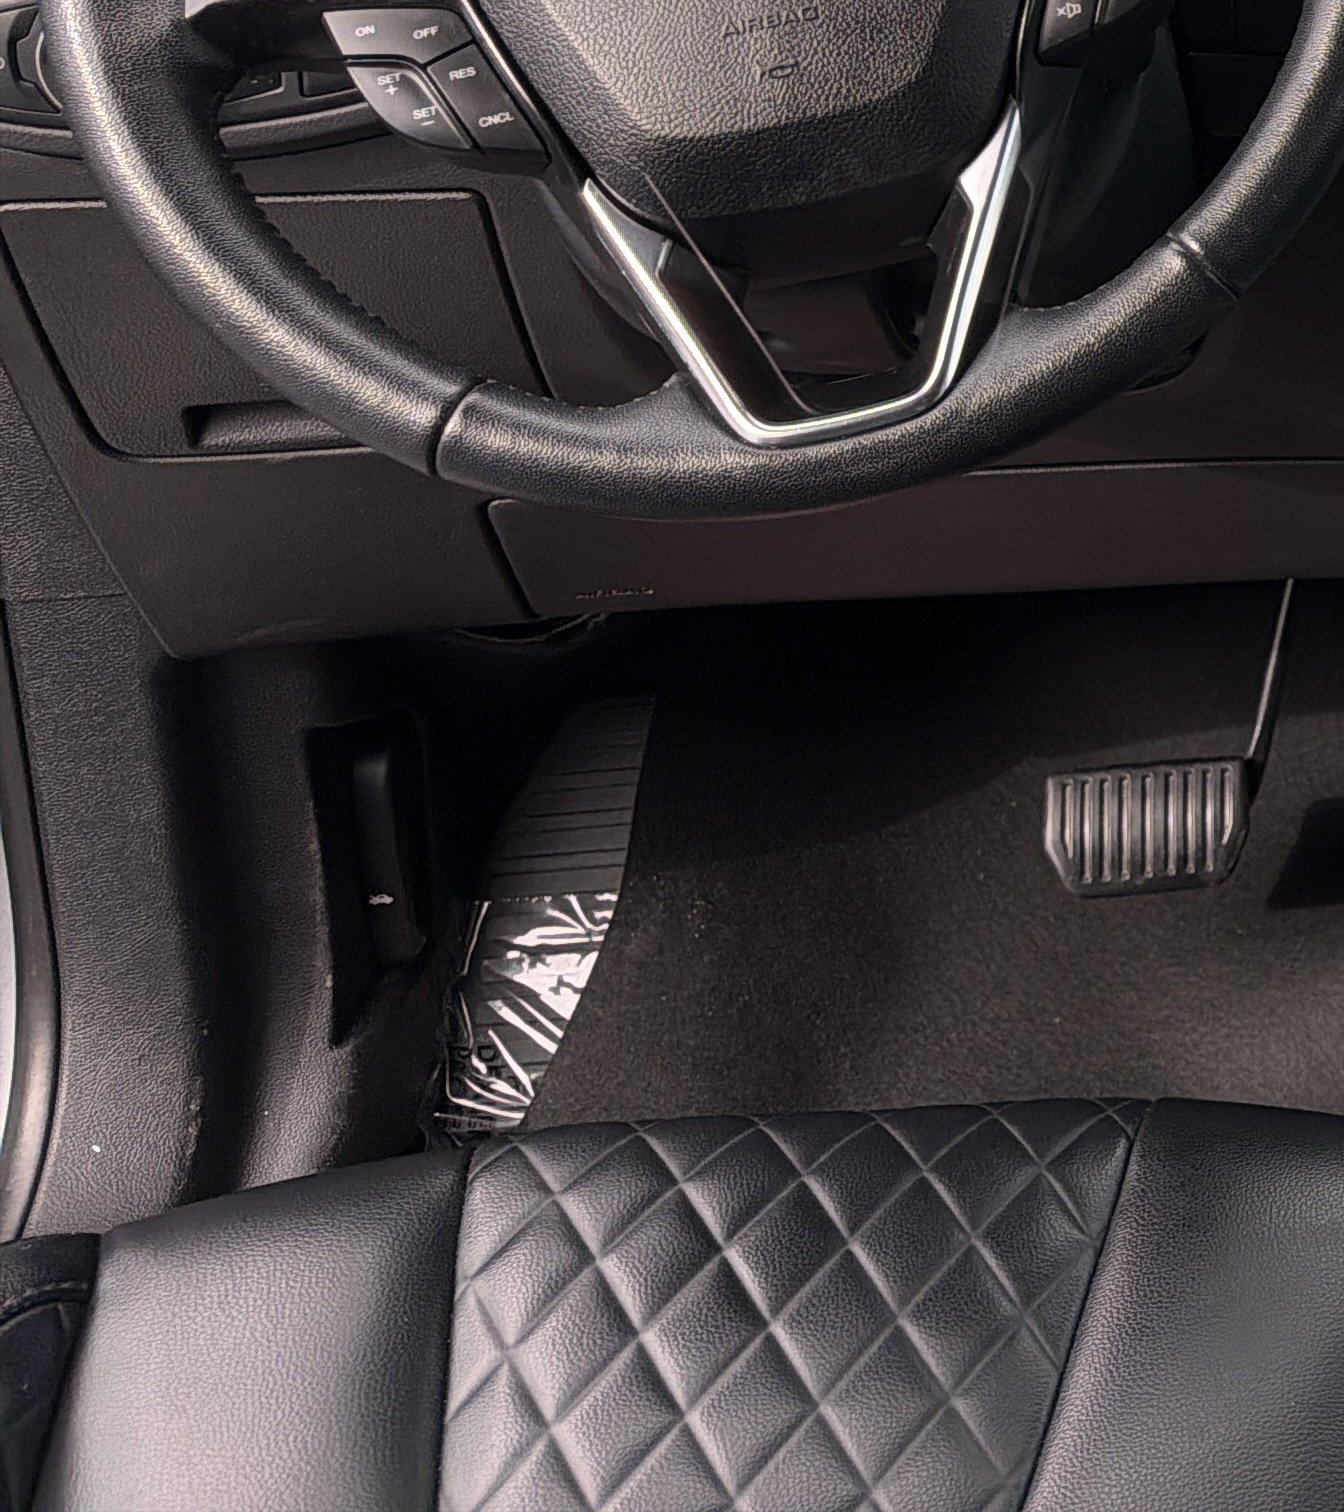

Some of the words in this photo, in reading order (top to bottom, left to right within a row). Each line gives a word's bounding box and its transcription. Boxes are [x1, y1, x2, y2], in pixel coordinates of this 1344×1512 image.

[723, 5, 820, 38] AIRBAG
[354, 24, 376, 38] ON
[412, 25, 440, 40] OFF
[376, 72, 401, 87] SET
[448, 66, 477, 81] RES
[412, 105, 438, 120] SET
[478, 111, 515, 128] CNCL
